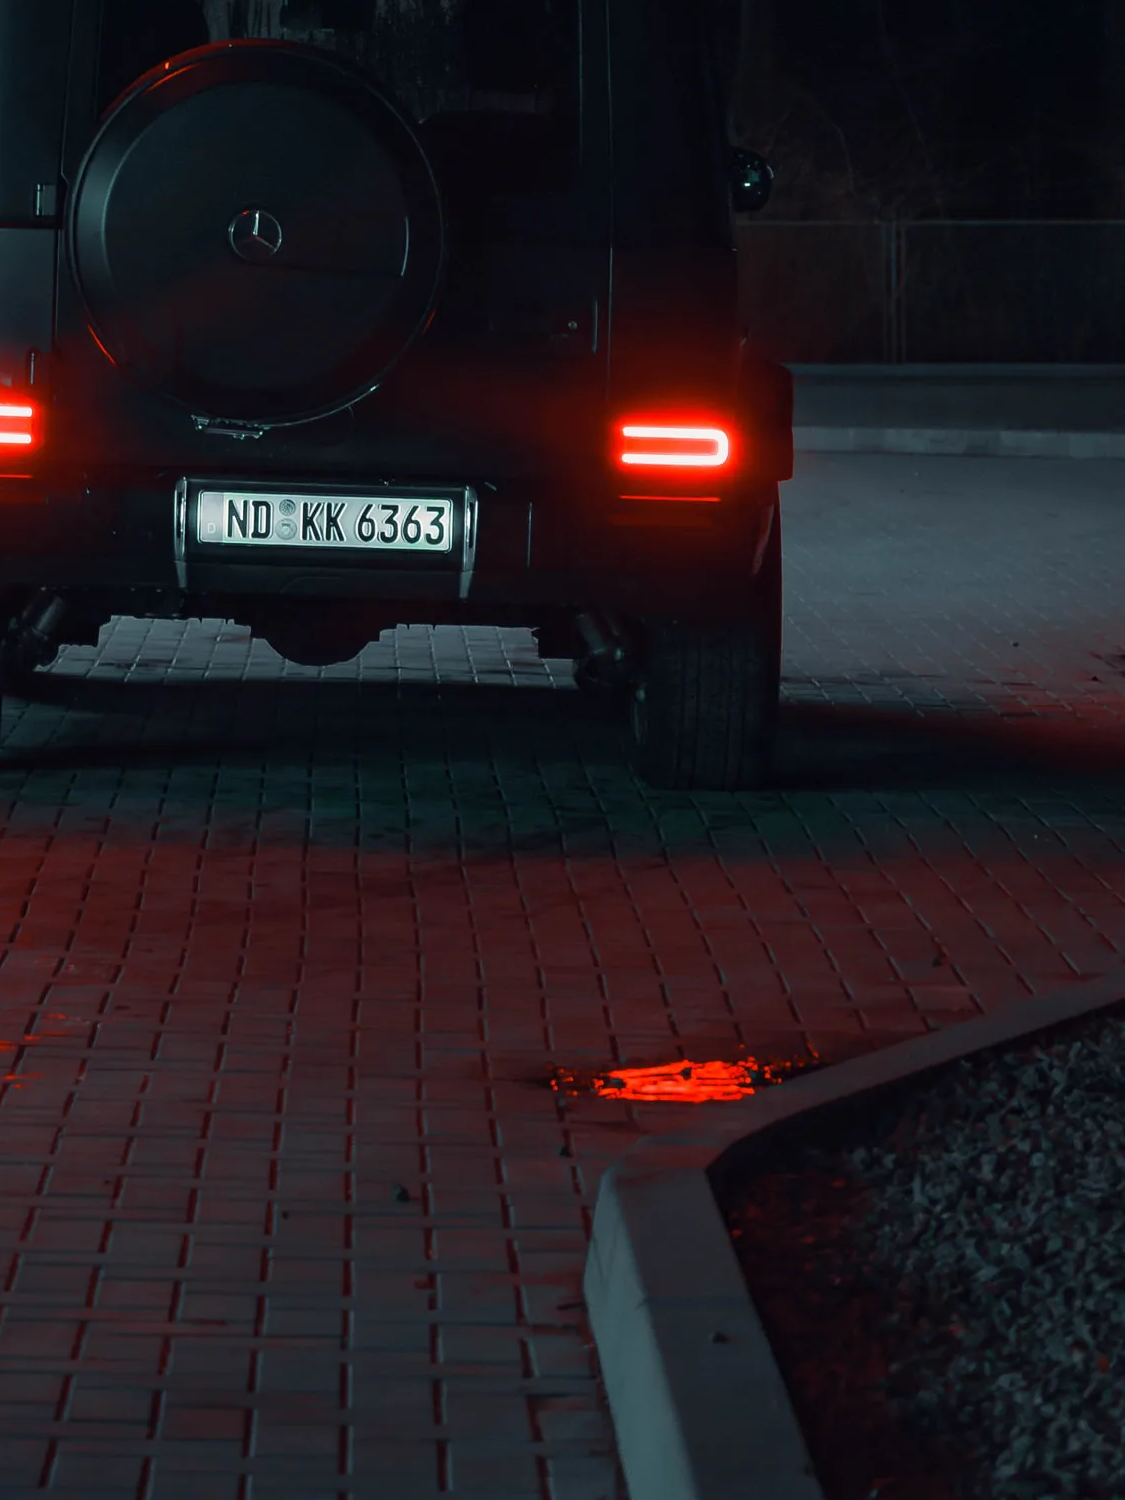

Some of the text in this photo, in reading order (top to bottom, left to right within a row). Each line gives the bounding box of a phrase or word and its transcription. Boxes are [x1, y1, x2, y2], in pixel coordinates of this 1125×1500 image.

[207, 522, 216, 534] D
[227, 499, 445, 546] ND KK 6363
